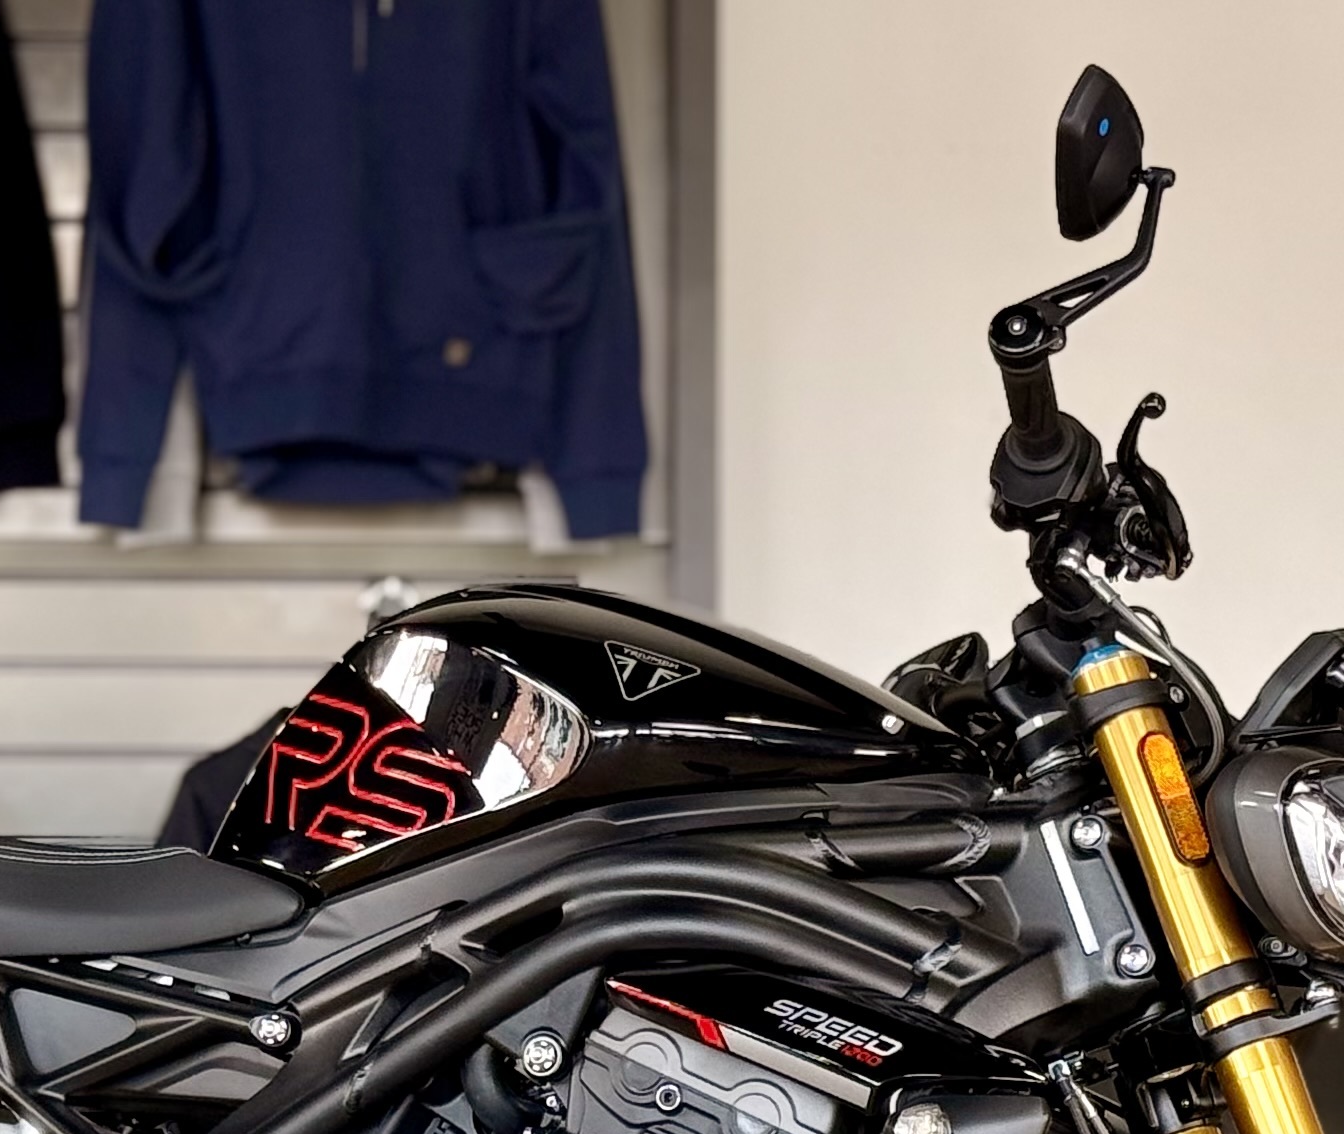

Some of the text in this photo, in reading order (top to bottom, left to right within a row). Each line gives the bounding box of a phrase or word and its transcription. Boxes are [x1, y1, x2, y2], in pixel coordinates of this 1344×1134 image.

[264, 693, 472, 852] RS
[763, 999, 904, 1057] SPEED
[778, 1019, 846, 1051] TRIPLE
